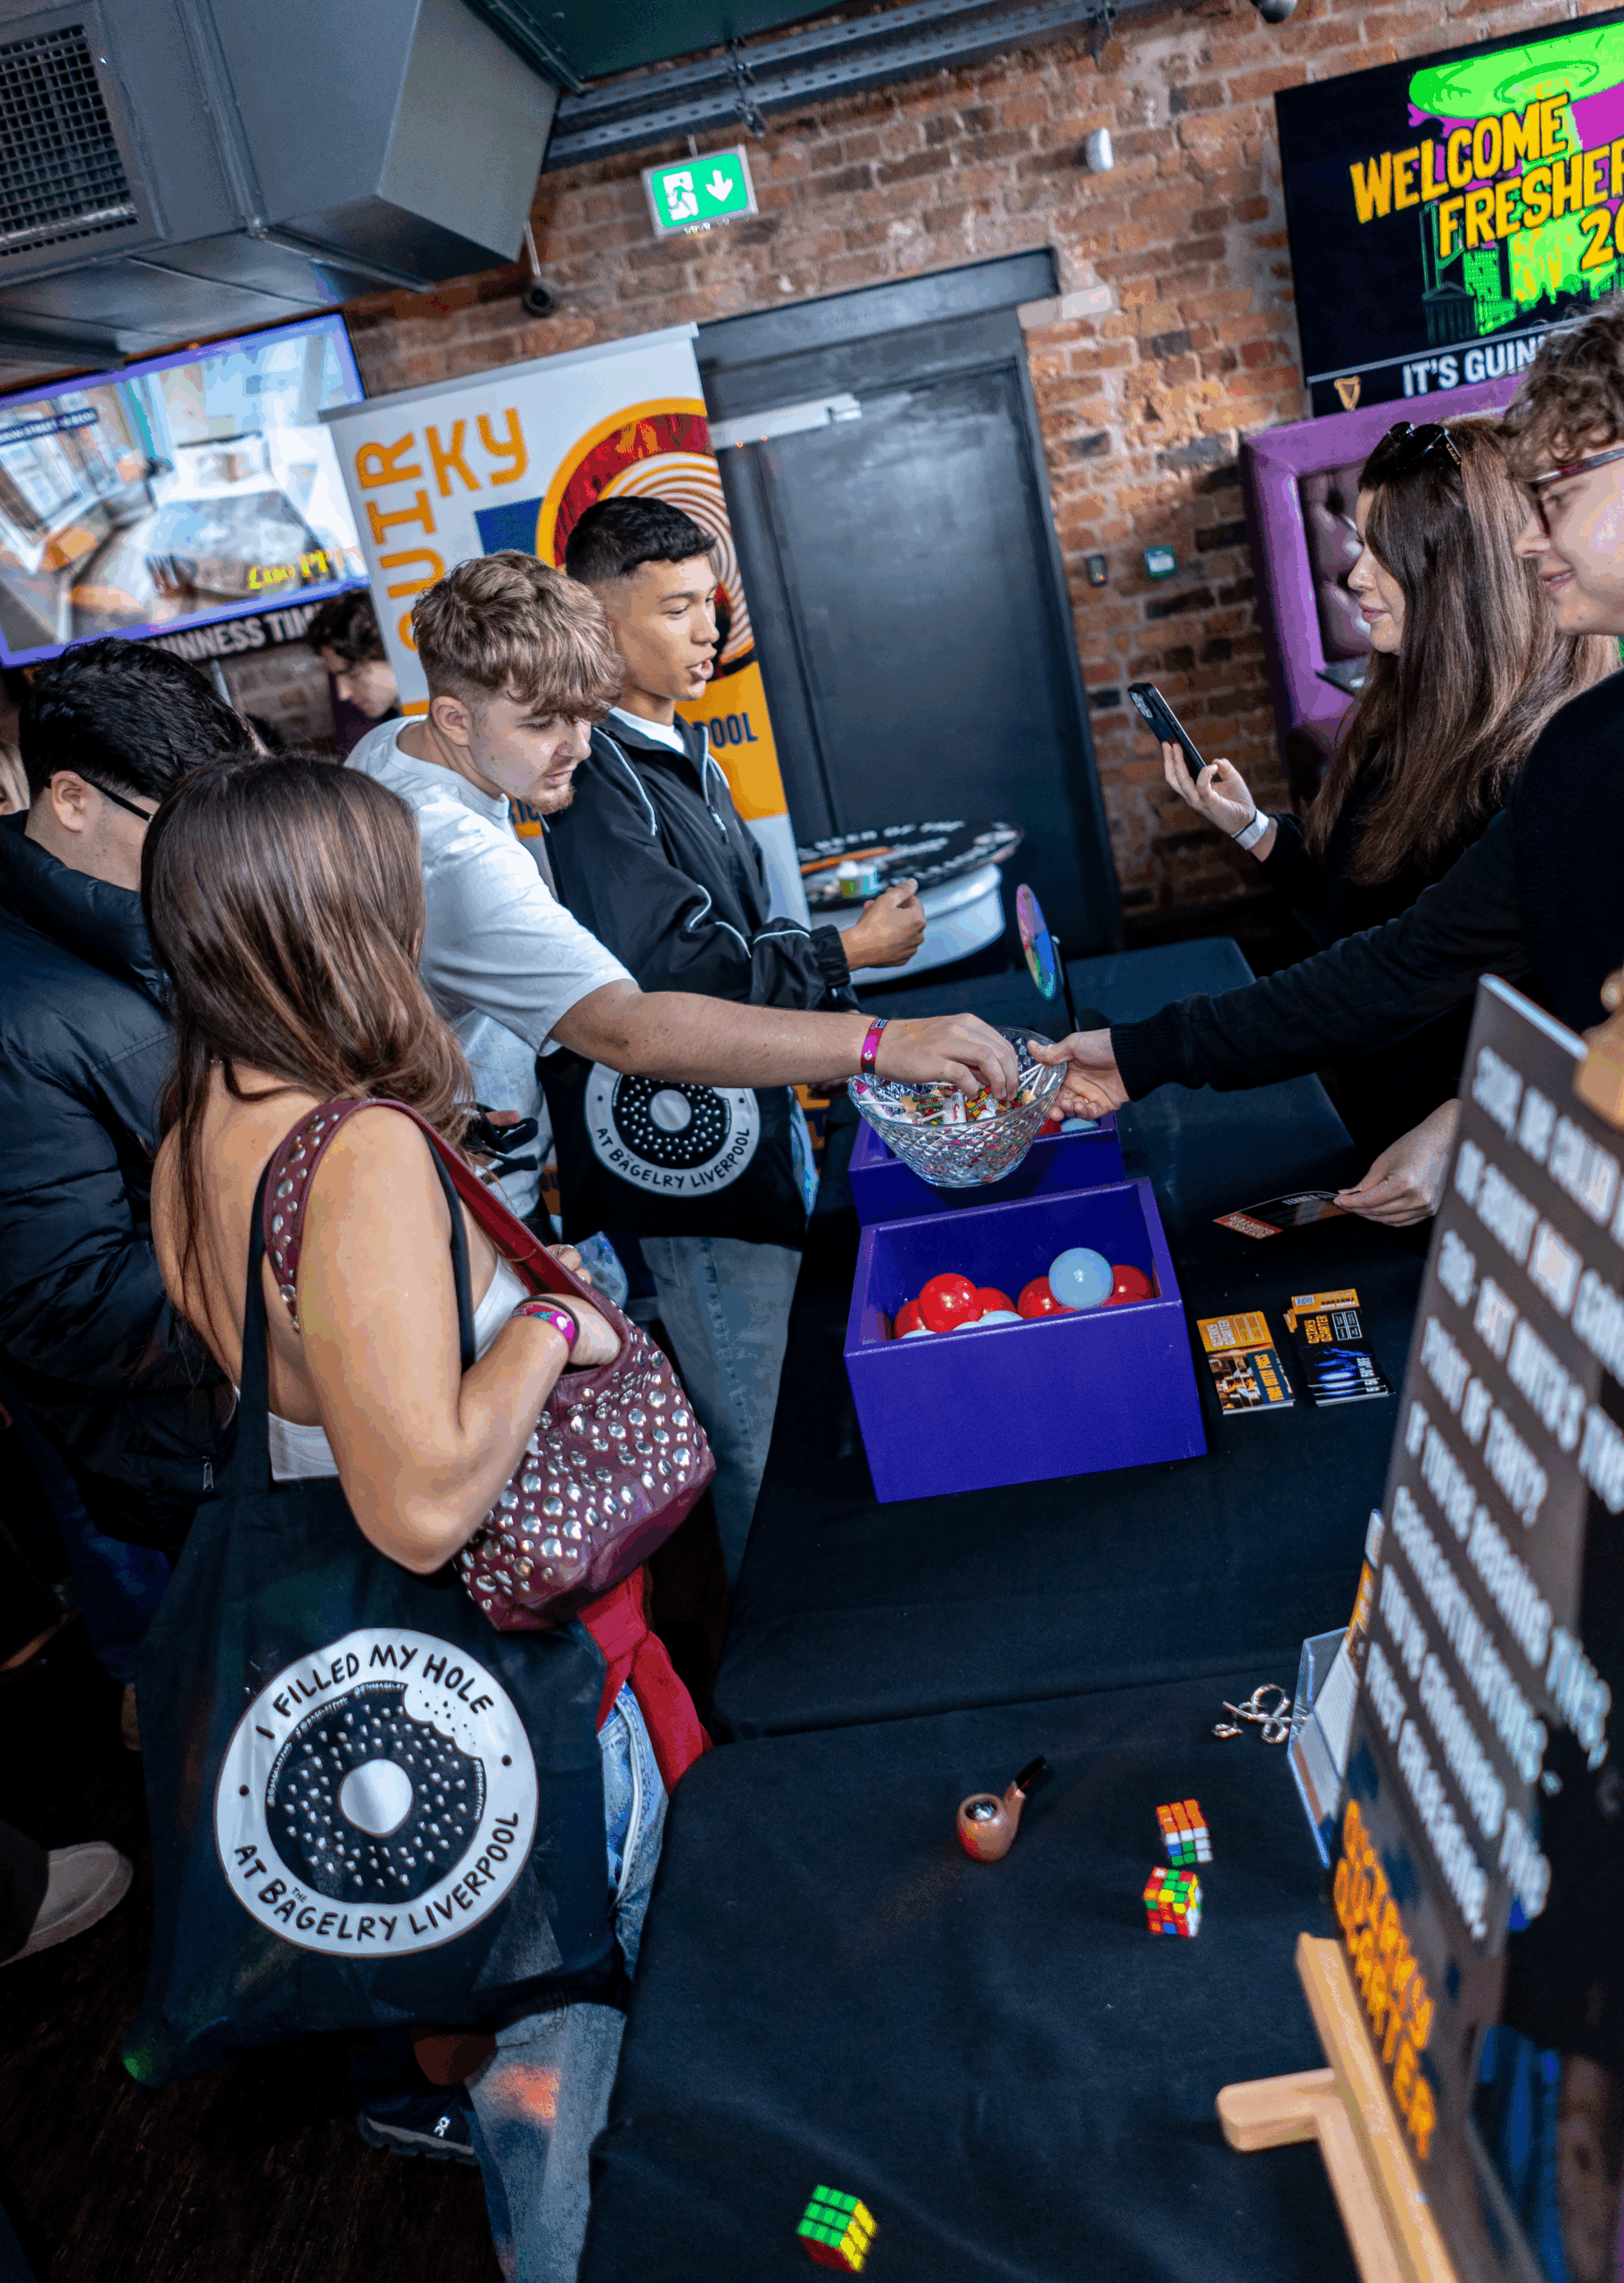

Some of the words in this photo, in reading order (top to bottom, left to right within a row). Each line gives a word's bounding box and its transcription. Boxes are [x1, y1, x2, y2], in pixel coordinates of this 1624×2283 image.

[1349, 93, 1570, 224] WELCOME
[1403, 356, 1459, 398] IT'S
[1463, 335, 1546, 385] GUIN
[425, 406, 530, 498] KY
[693, 713, 758, 747] OOL
[596, 1127, 614, 1148] AT
[609, 1148, 685, 1189] BAGELRY
[690, 1127, 751, 1189] LIVERPOOL
[255, 1724, 276, 1740] I
[273, 1652, 359, 1718] FILLED
[369, 1644, 418, 1671] MY
[422, 1653, 495, 1715] HOLE
[234, 1844, 268, 1879] AT
[258, 1878, 399, 1941] BAGELRY
[408, 1812, 519, 1935] LIVERPOOL
[291, 1886, 308, 1903] THE
